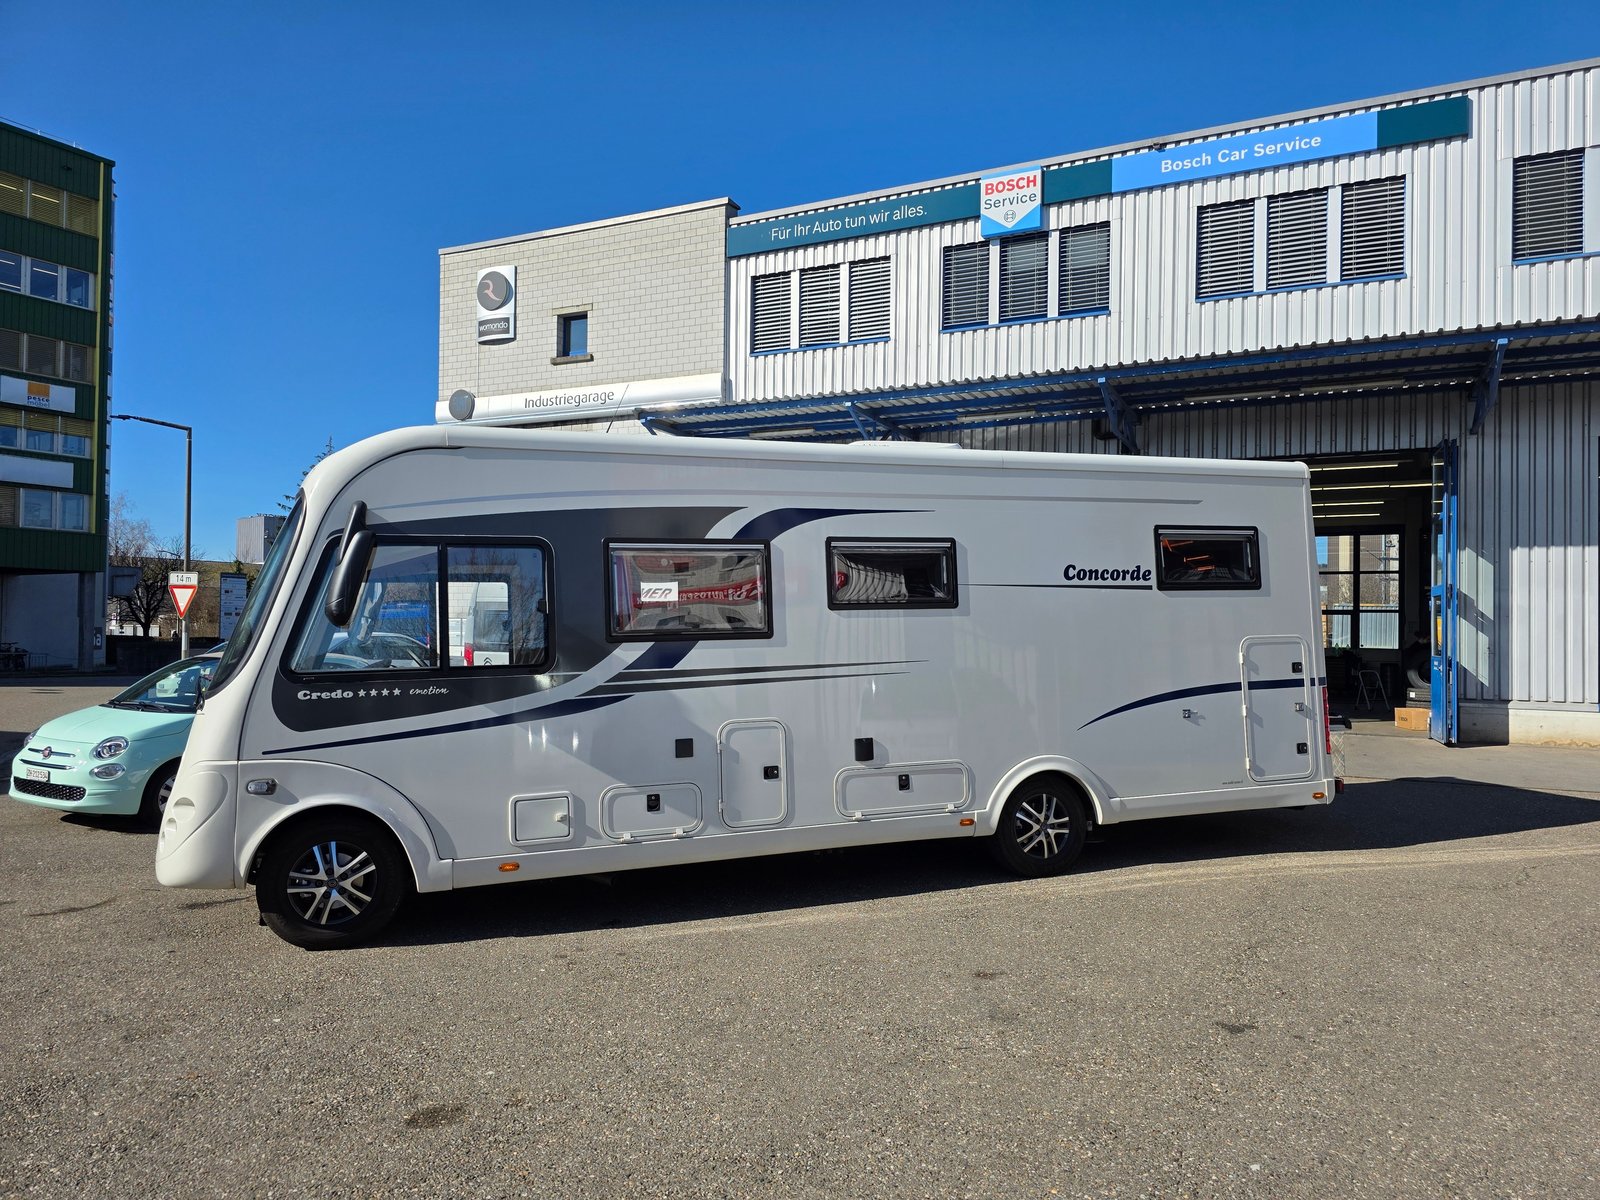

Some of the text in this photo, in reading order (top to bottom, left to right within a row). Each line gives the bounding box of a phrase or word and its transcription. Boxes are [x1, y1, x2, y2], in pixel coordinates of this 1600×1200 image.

[1160, 134, 1322, 174] Bosch Car Service
[984, 174, 1037, 196] BOSCH
[984, 192, 1037, 210] Service
[771, 204, 928, 241] Für Ihr Auto tun wir alles.
[478, 321, 509, 332] womondo
[524, 390, 615, 409] Industriegarage
[176, 575, 184, 583] 14
[1063, 564, 1152, 581] Concorde
[297, 686, 450, 700] Credo emotion
